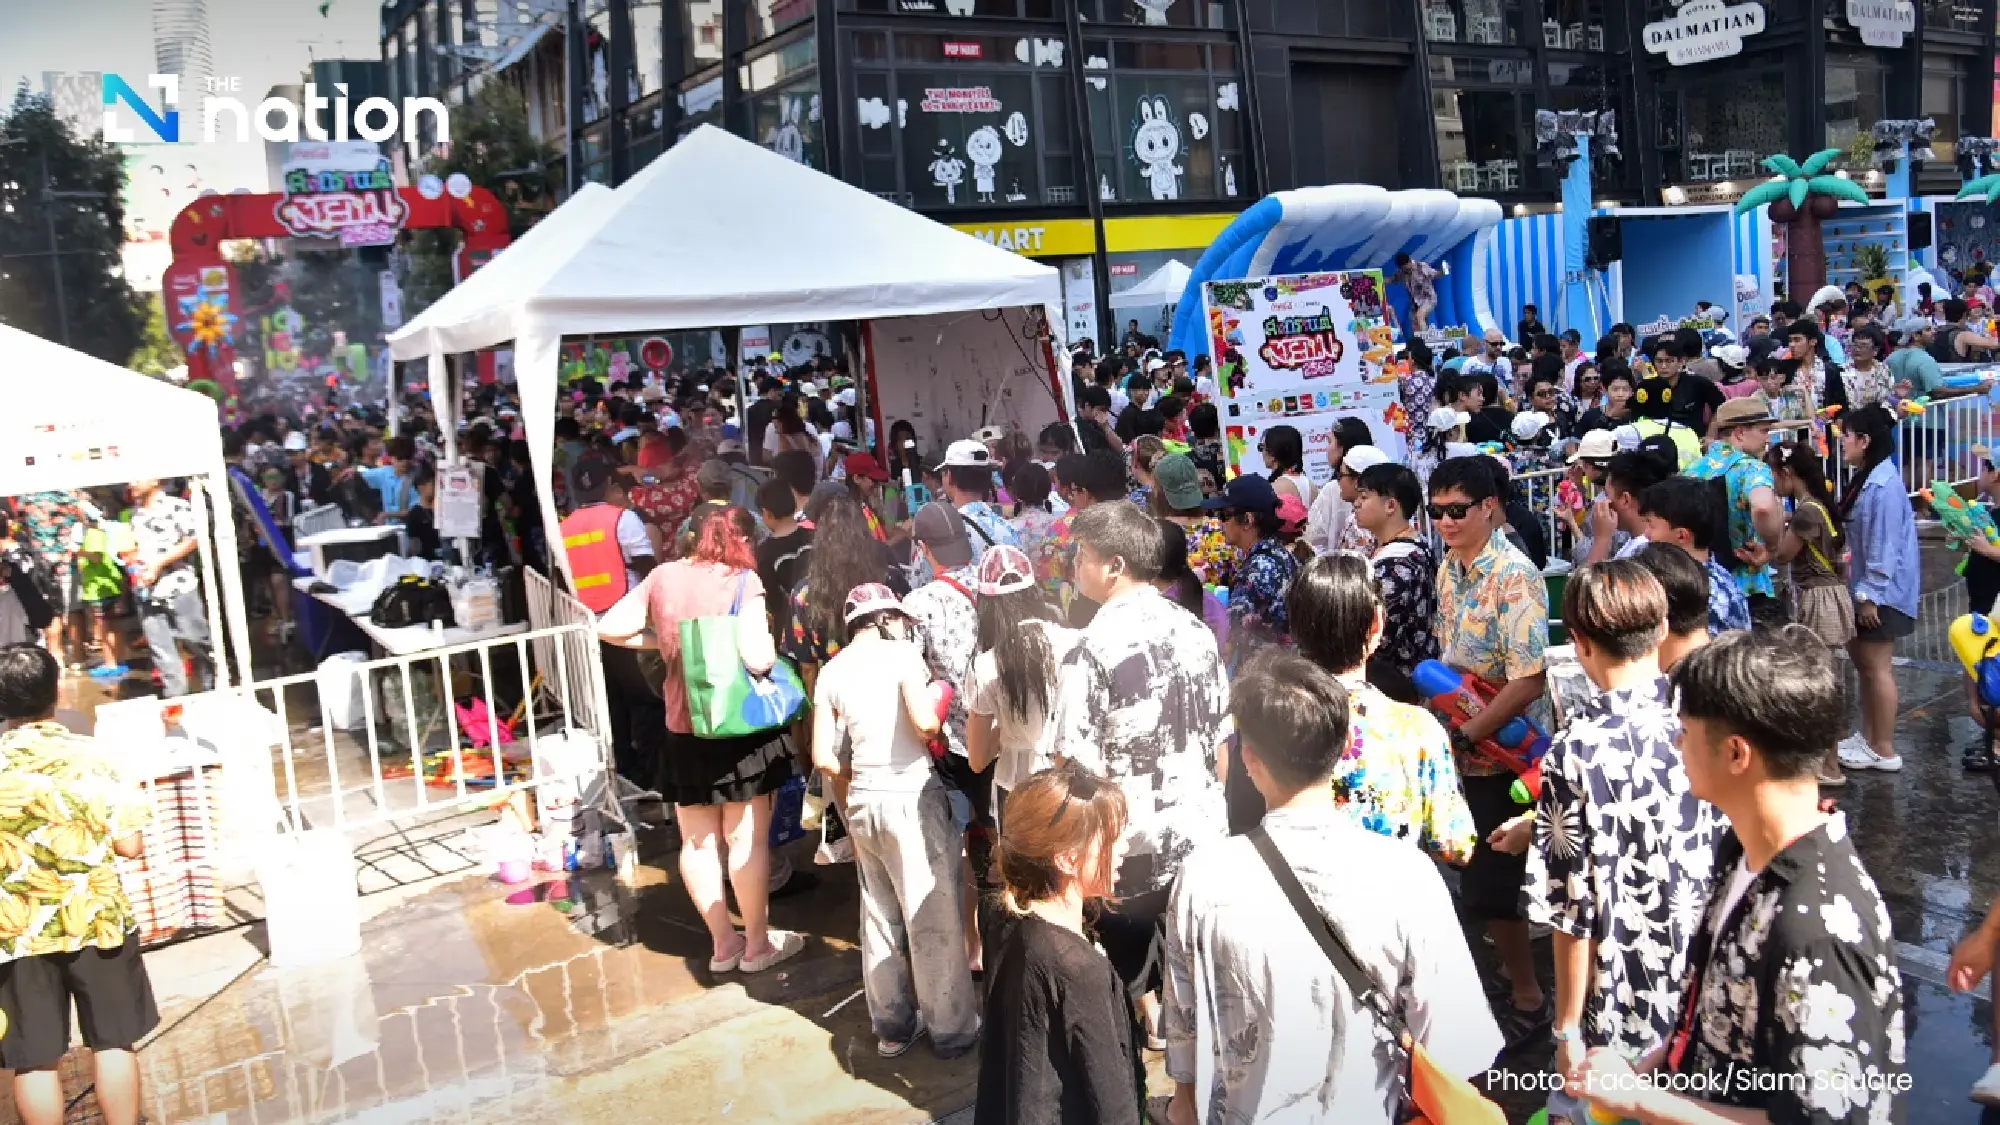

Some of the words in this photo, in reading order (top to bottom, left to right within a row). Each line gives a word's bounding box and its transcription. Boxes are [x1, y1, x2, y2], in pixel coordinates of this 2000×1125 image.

[1851, 2, 1912, 24] DALMATIAN
[1651, 12, 1755, 45] DALMATIAN
[974, 228, 1045, 250] MART
